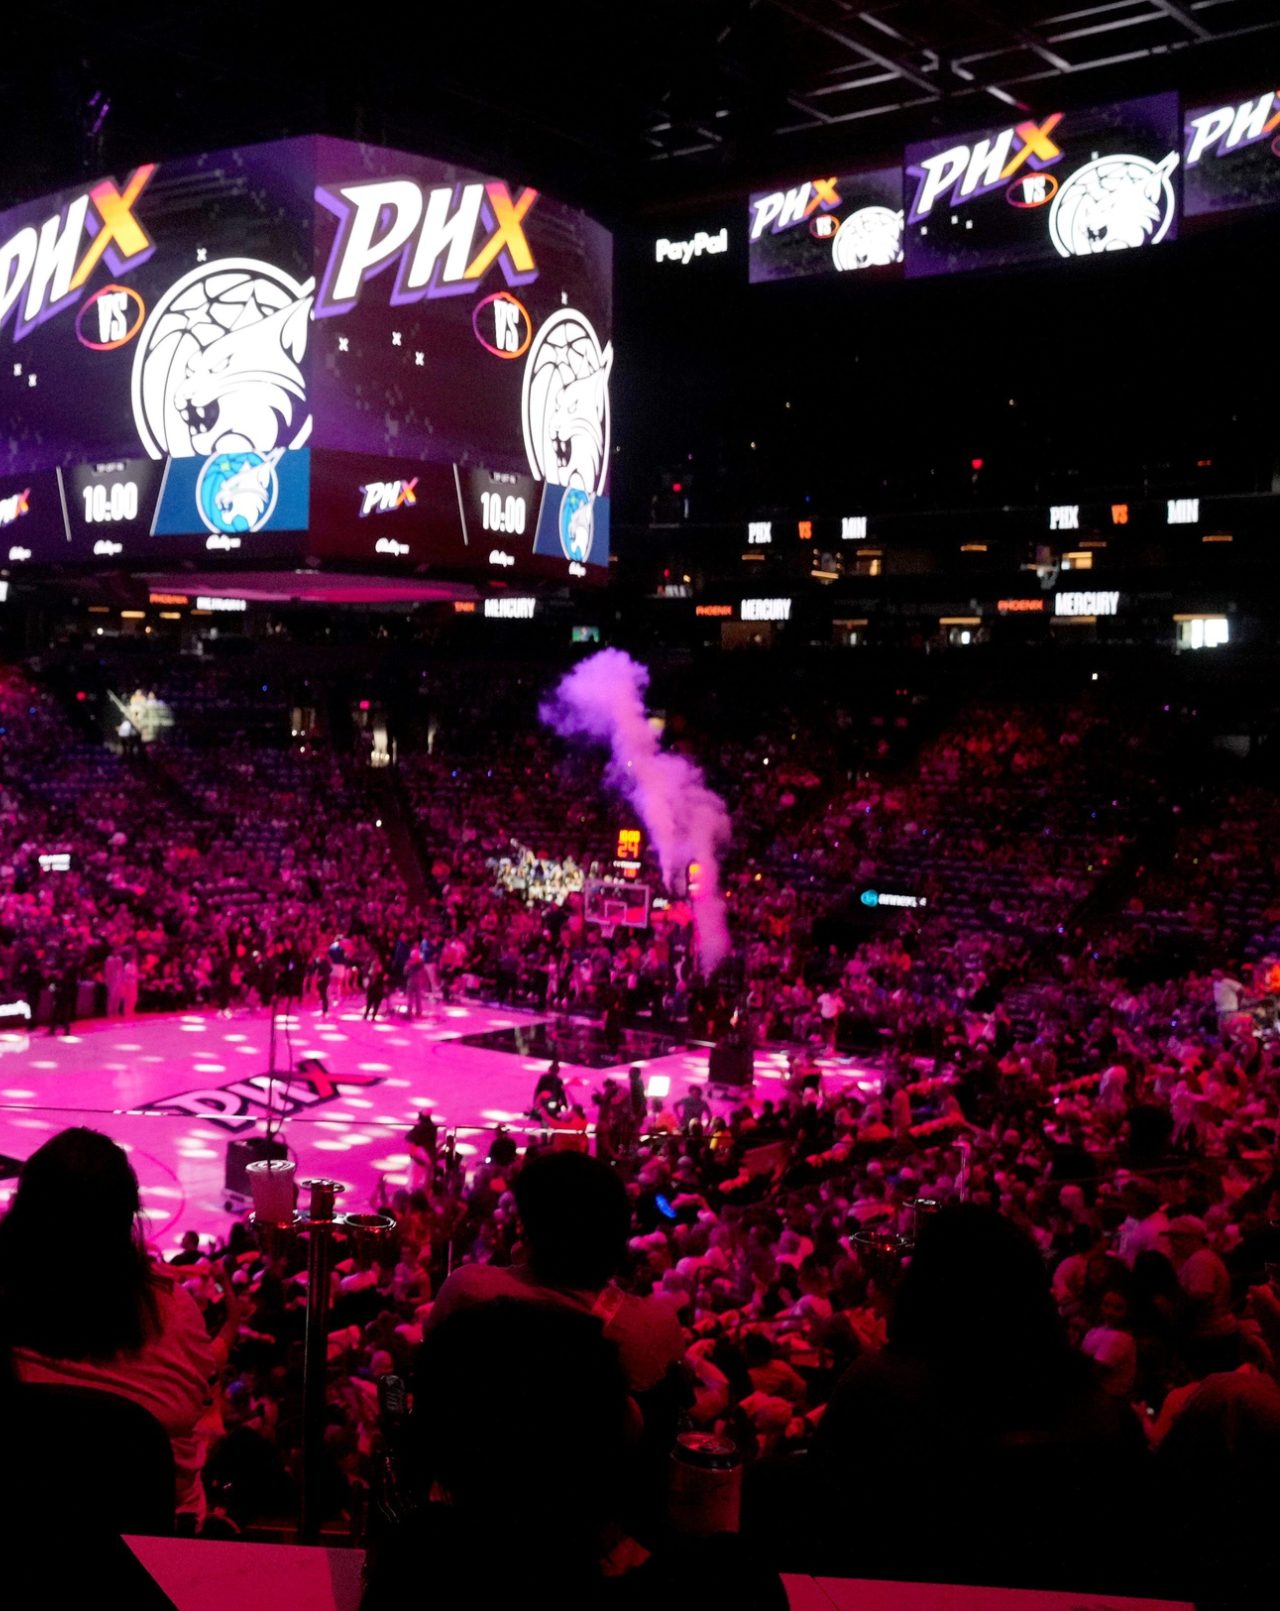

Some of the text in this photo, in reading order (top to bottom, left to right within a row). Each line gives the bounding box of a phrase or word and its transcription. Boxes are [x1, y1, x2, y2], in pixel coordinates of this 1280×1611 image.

[917, 111, 1065, 216] PHX
[751, 177, 839, 240] PHX
[1023, 175, 1046, 205] VS
[332, 179, 539, 300] PHX
[656, 228, 727, 264] PayPal
[97, 292, 128, 343] VS
[493, 299, 519, 353] VS
[83, 482, 138, 522] 10:00
[362, 477, 418, 514] PHX
[481, 492, 525, 534] 10:00
[1050, 499, 1199, 529] PHX VS MIN
[748, 522, 771, 543] PHX
[799, 521, 811, 539] VS
[696, 599, 791, 620] PHOENIX MERCURY
[998, 591, 1120, 615] PHOENIX MERCURY
